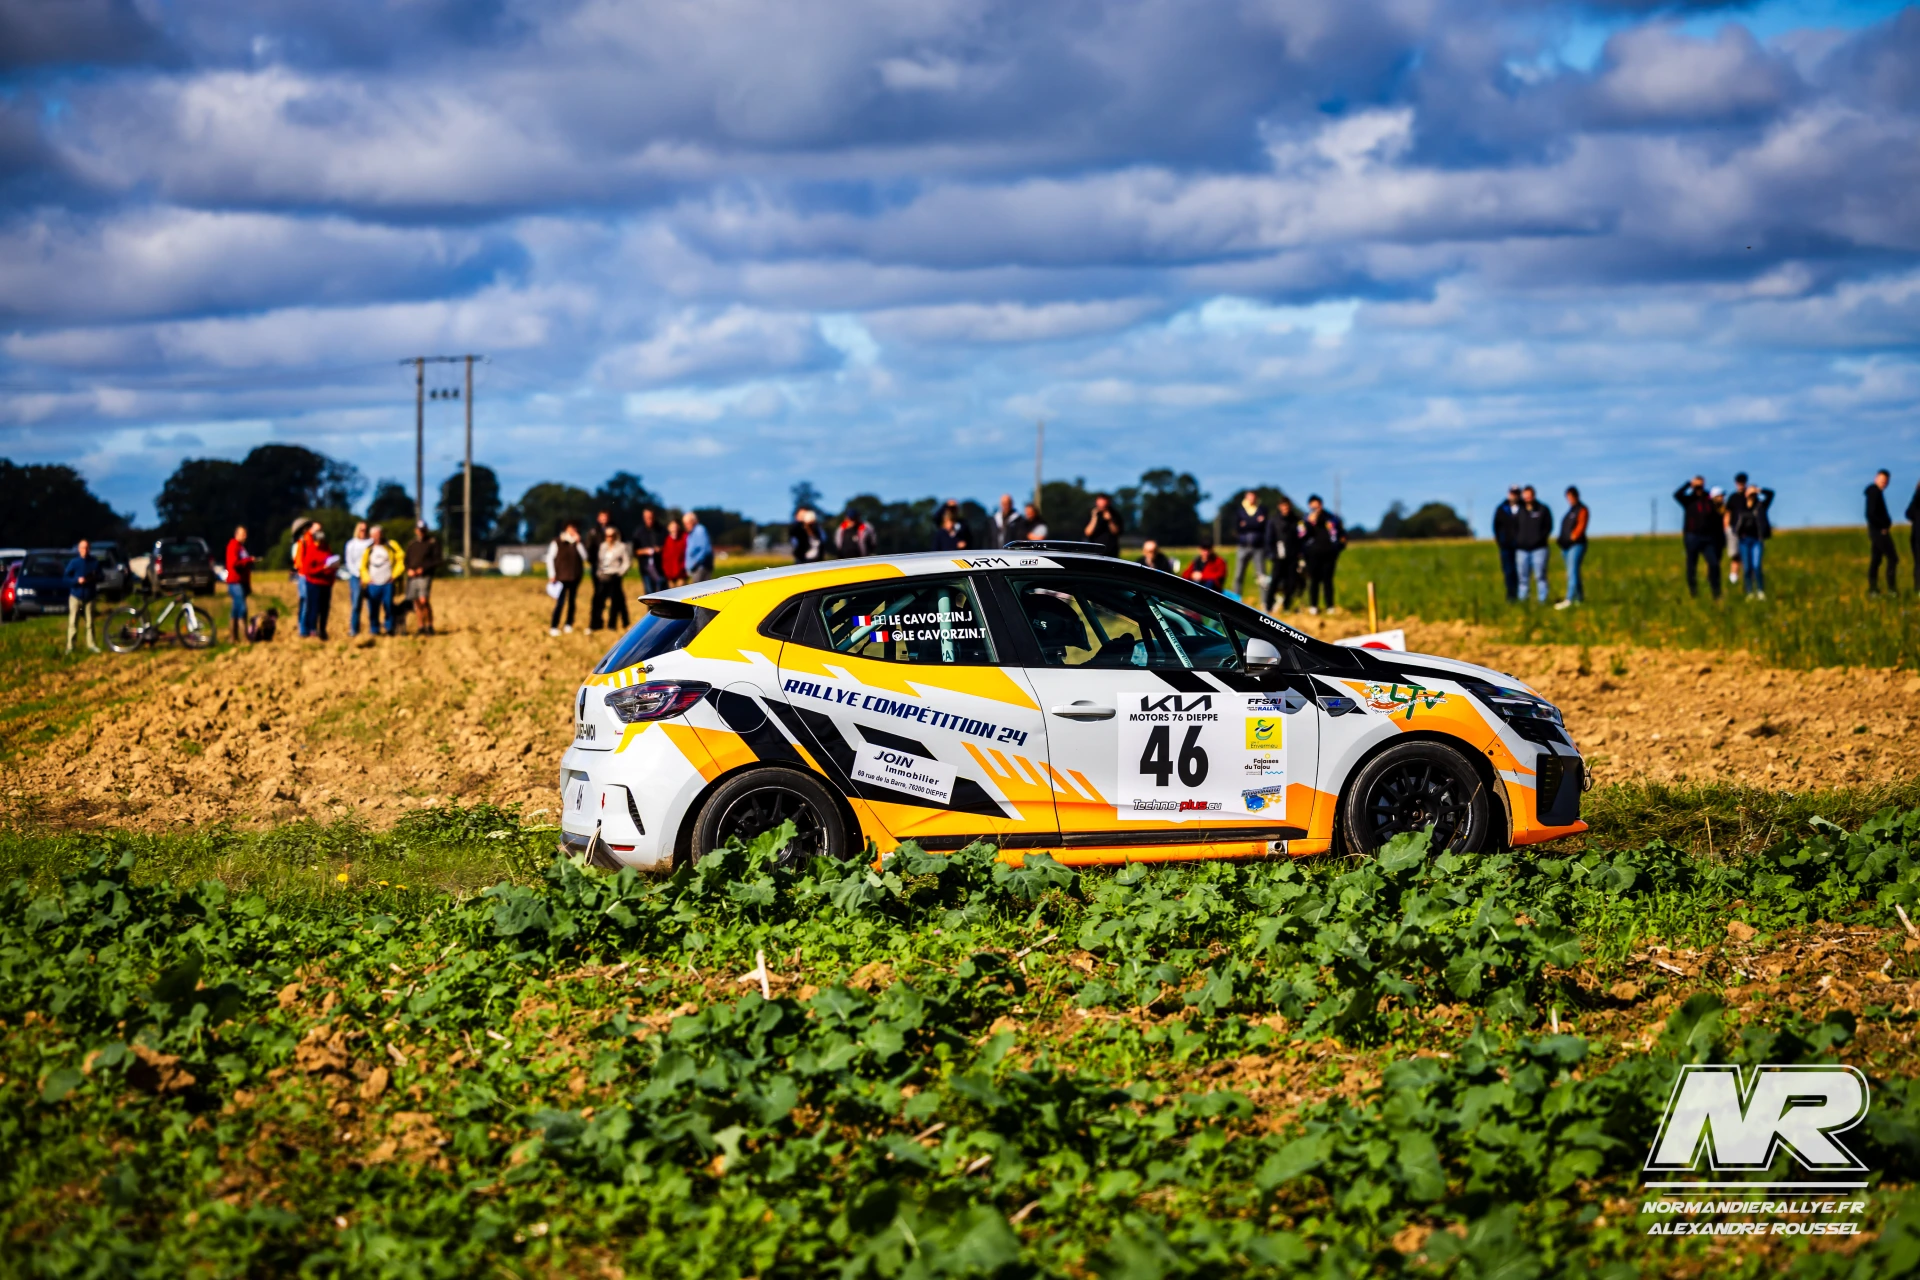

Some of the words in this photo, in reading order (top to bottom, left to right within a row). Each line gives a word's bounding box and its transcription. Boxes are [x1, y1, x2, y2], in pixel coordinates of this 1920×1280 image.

[889, 614, 901, 626] LE
[903, 610, 973, 625] CAVORZIN.J
[903, 630, 915, 641] LE
[917, 627, 987, 641] CAVORZIN.T
[1258, 615, 1308, 644] LOUEZ-MOI
[784, 679, 861, 707] RALLYE
[862, 693, 997, 738] COMPÉTITION
[997, 727, 1029, 746] 24
[1129, 713, 1170, 721] MOTORS
[1172, 713, 1184, 721] 76
[1186, 713, 1219, 721] DIEPPE
[873, 750, 914, 769] JOIN
[1140, 725, 1209, 788] 46
[865, 773, 876, 781] rue
[875, 774, 884, 782] de
[908, 783, 925, 793] 76200
[925, 787, 948, 799] DIEPPE
[885, 764, 940, 786] Immobilier
